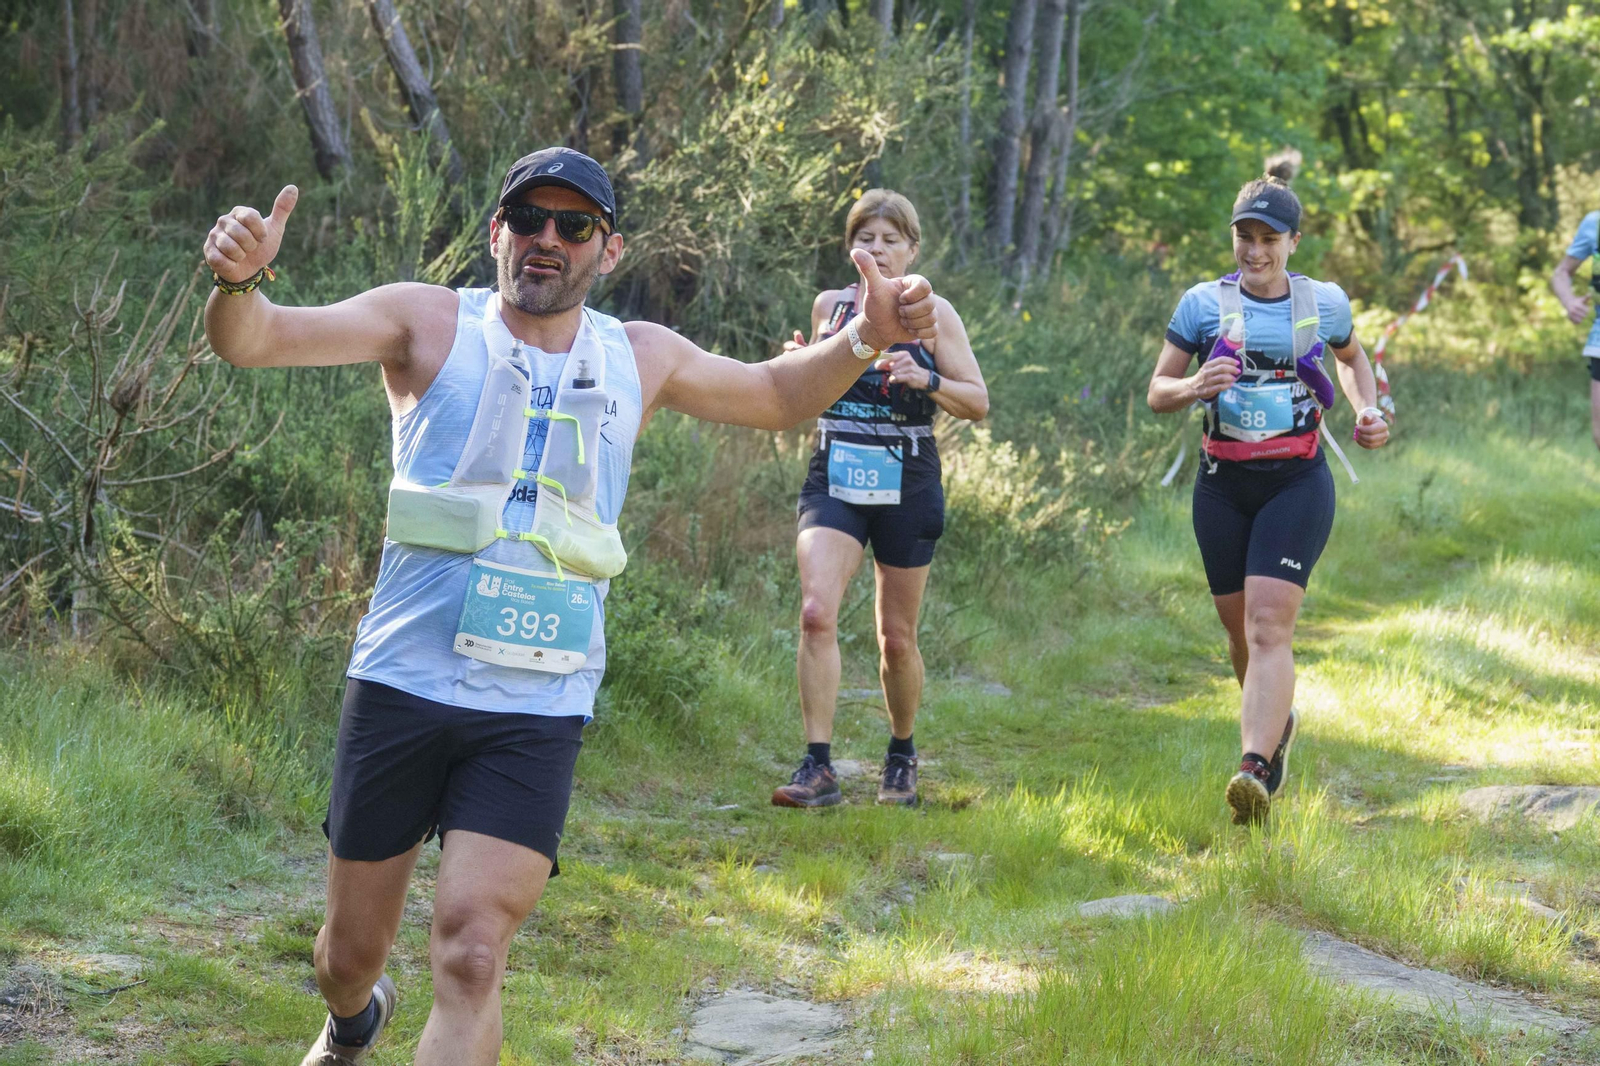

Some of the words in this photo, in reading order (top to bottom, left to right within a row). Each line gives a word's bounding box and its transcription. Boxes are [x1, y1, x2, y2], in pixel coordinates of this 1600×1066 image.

[1240, 410, 1267, 428] 88
[846, 467, 879, 488] 193
[1280, 557, 1302, 571] FILA
[501, 589, 536, 601] Castelos
[502, 582, 524, 593] Entre
[496, 607, 561, 642] 393
